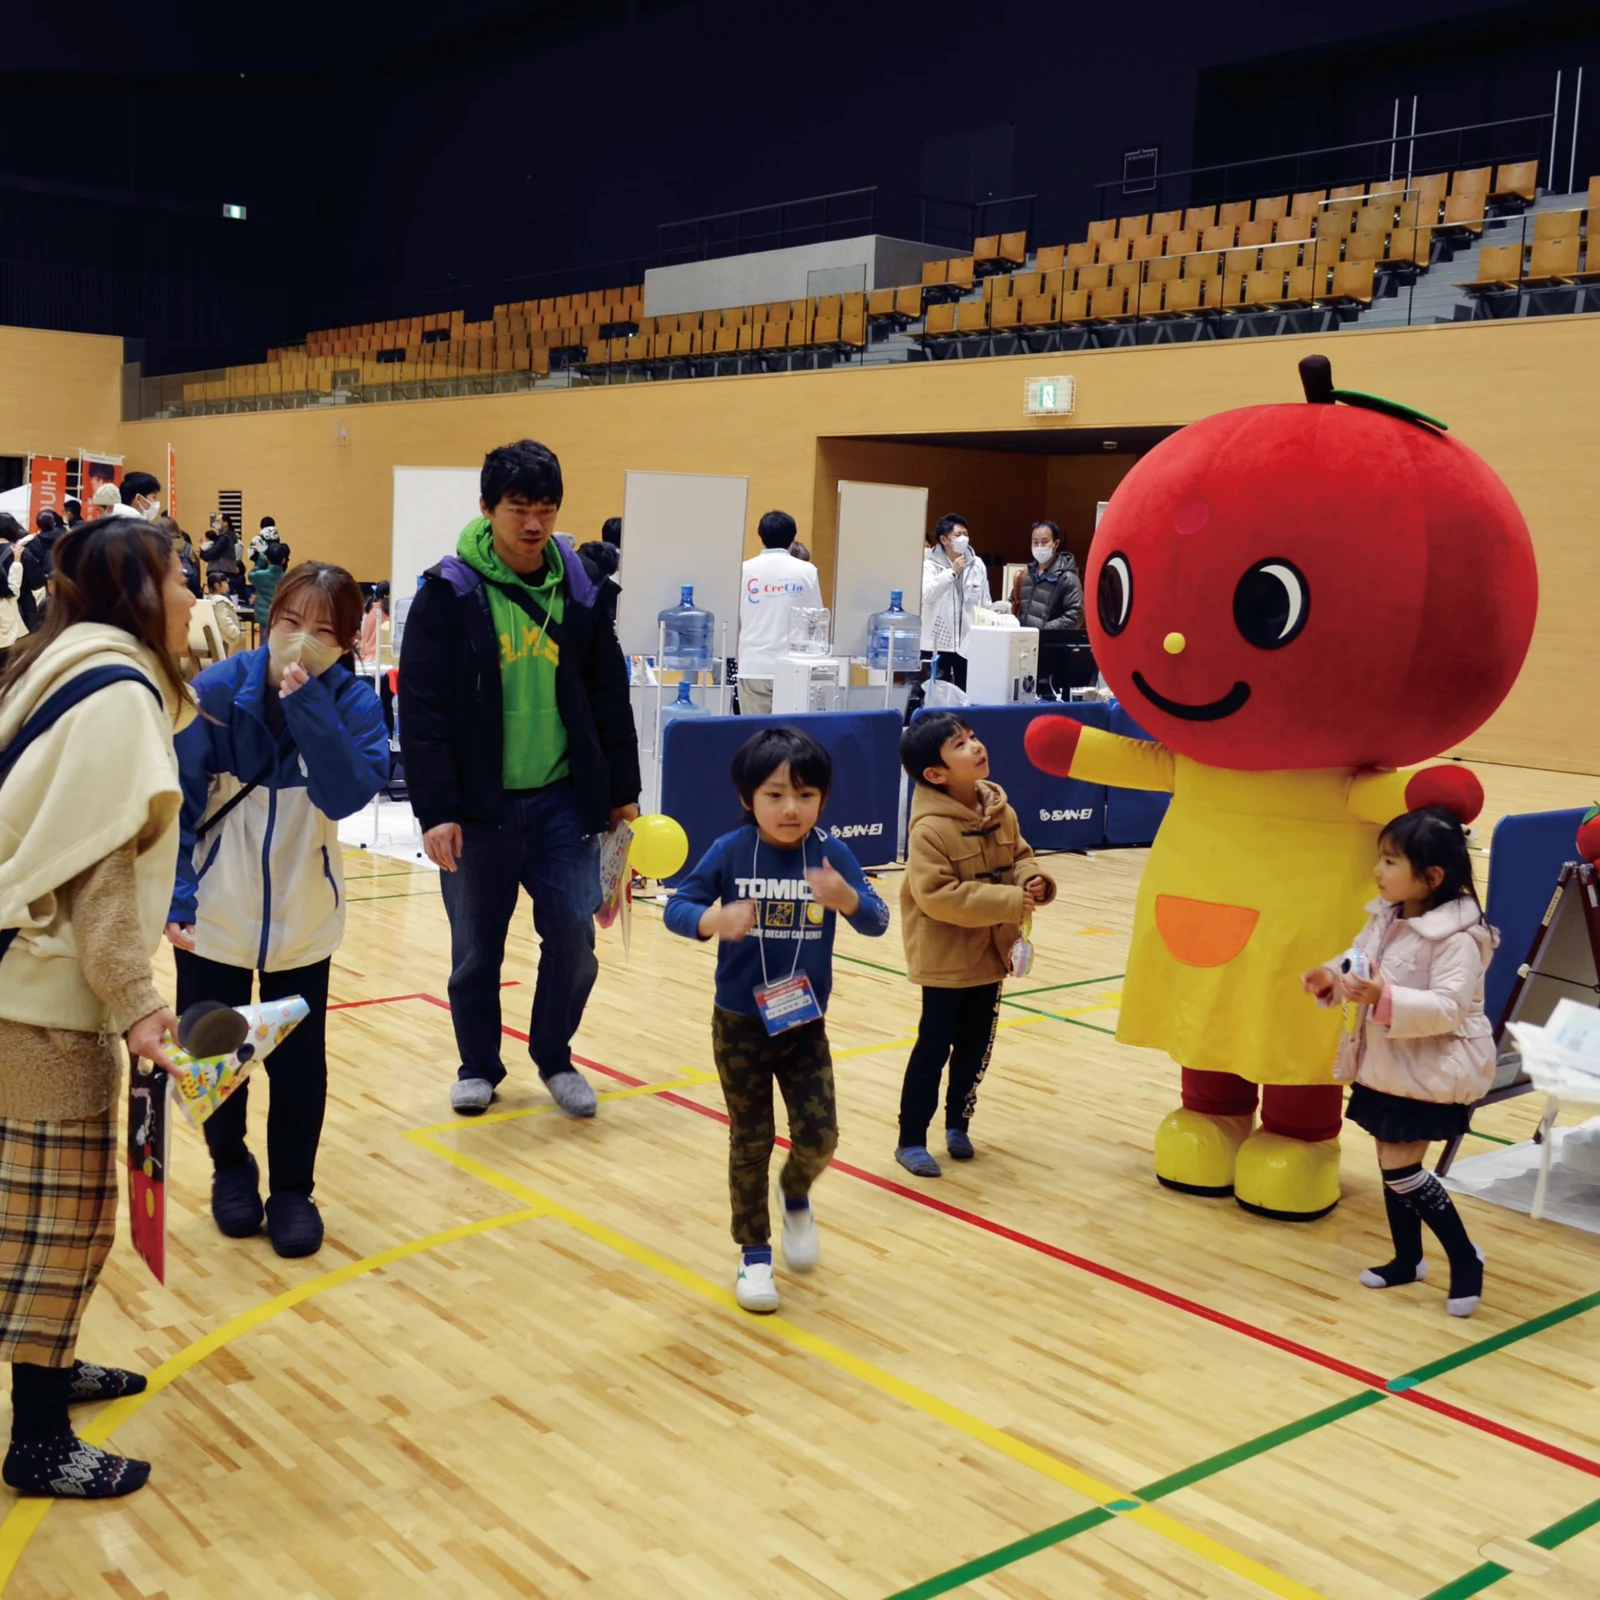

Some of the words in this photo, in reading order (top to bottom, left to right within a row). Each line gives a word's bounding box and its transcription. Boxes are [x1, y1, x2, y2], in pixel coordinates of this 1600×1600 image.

[764, 583, 803, 593] CreCla
[1051, 808, 1093, 821] SAN-EI
[842, 823, 883, 838] SAN-EI
[734, 878, 815, 900] TOMIC
[764, 929, 791, 939] DIECAST
